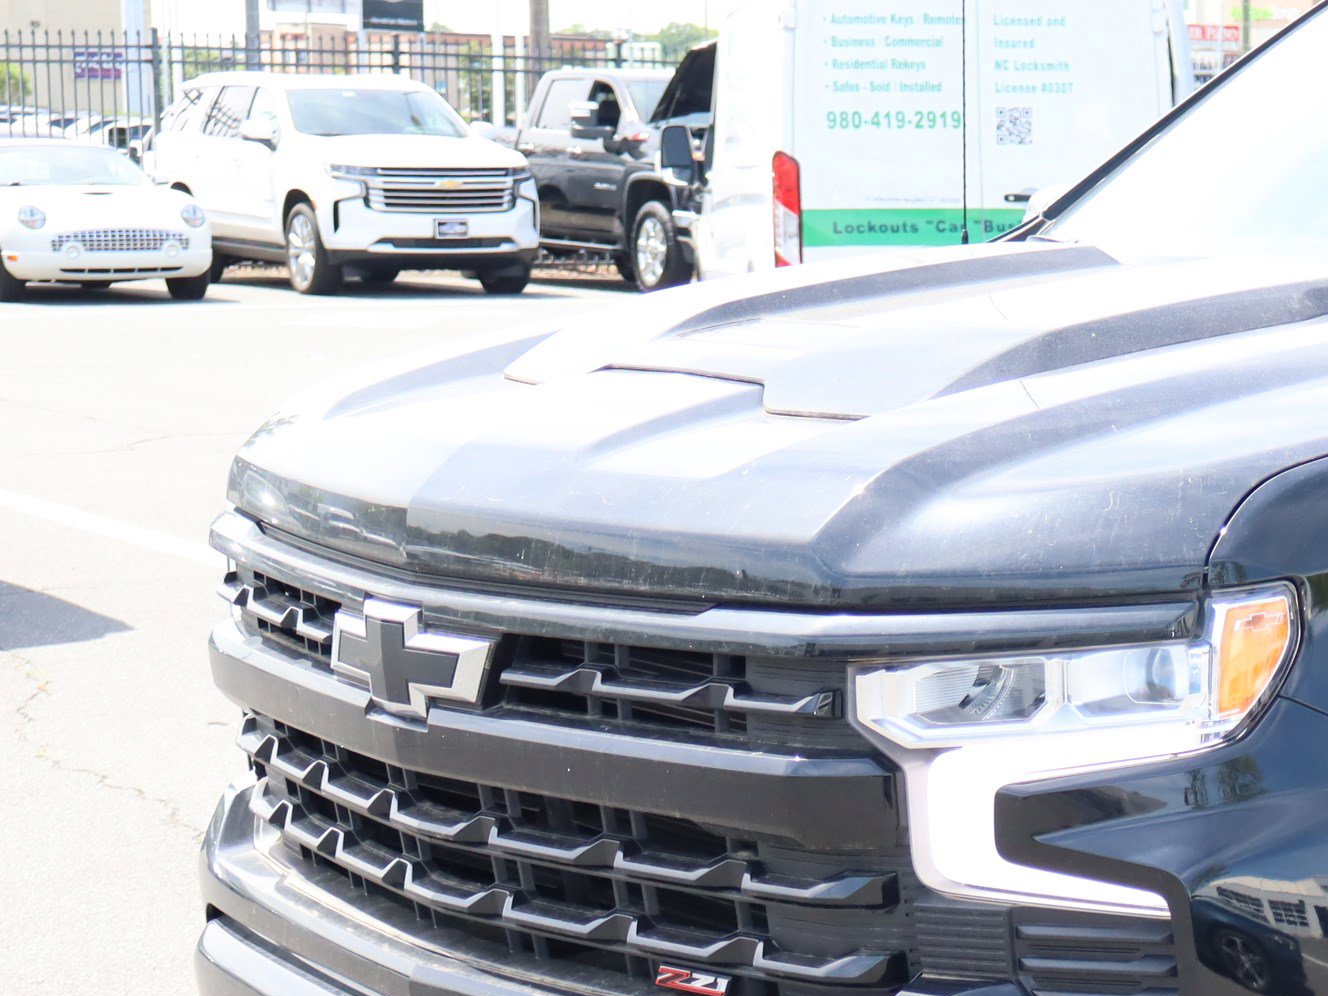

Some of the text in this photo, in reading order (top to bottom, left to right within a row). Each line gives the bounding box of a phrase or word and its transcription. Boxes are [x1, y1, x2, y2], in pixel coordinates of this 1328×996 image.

[830, 13, 887, 25] Automotive
[891, 13, 914, 27] Keys
[993, 14, 1067, 26] Licensed and
[831, 35, 943, 48] Business Commercial
[993, 37, 1036, 48] Insured
[832, 58, 926, 72] Residential Rekeys
[994, 59, 1071, 72] NC Locksmith
[833, 80, 943, 92] Safes Sold Installed
[994, 81, 1037, 94] License
[826, 110, 962, 129] 980-419-2919
[833, 220, 919, 234] Lockouts
